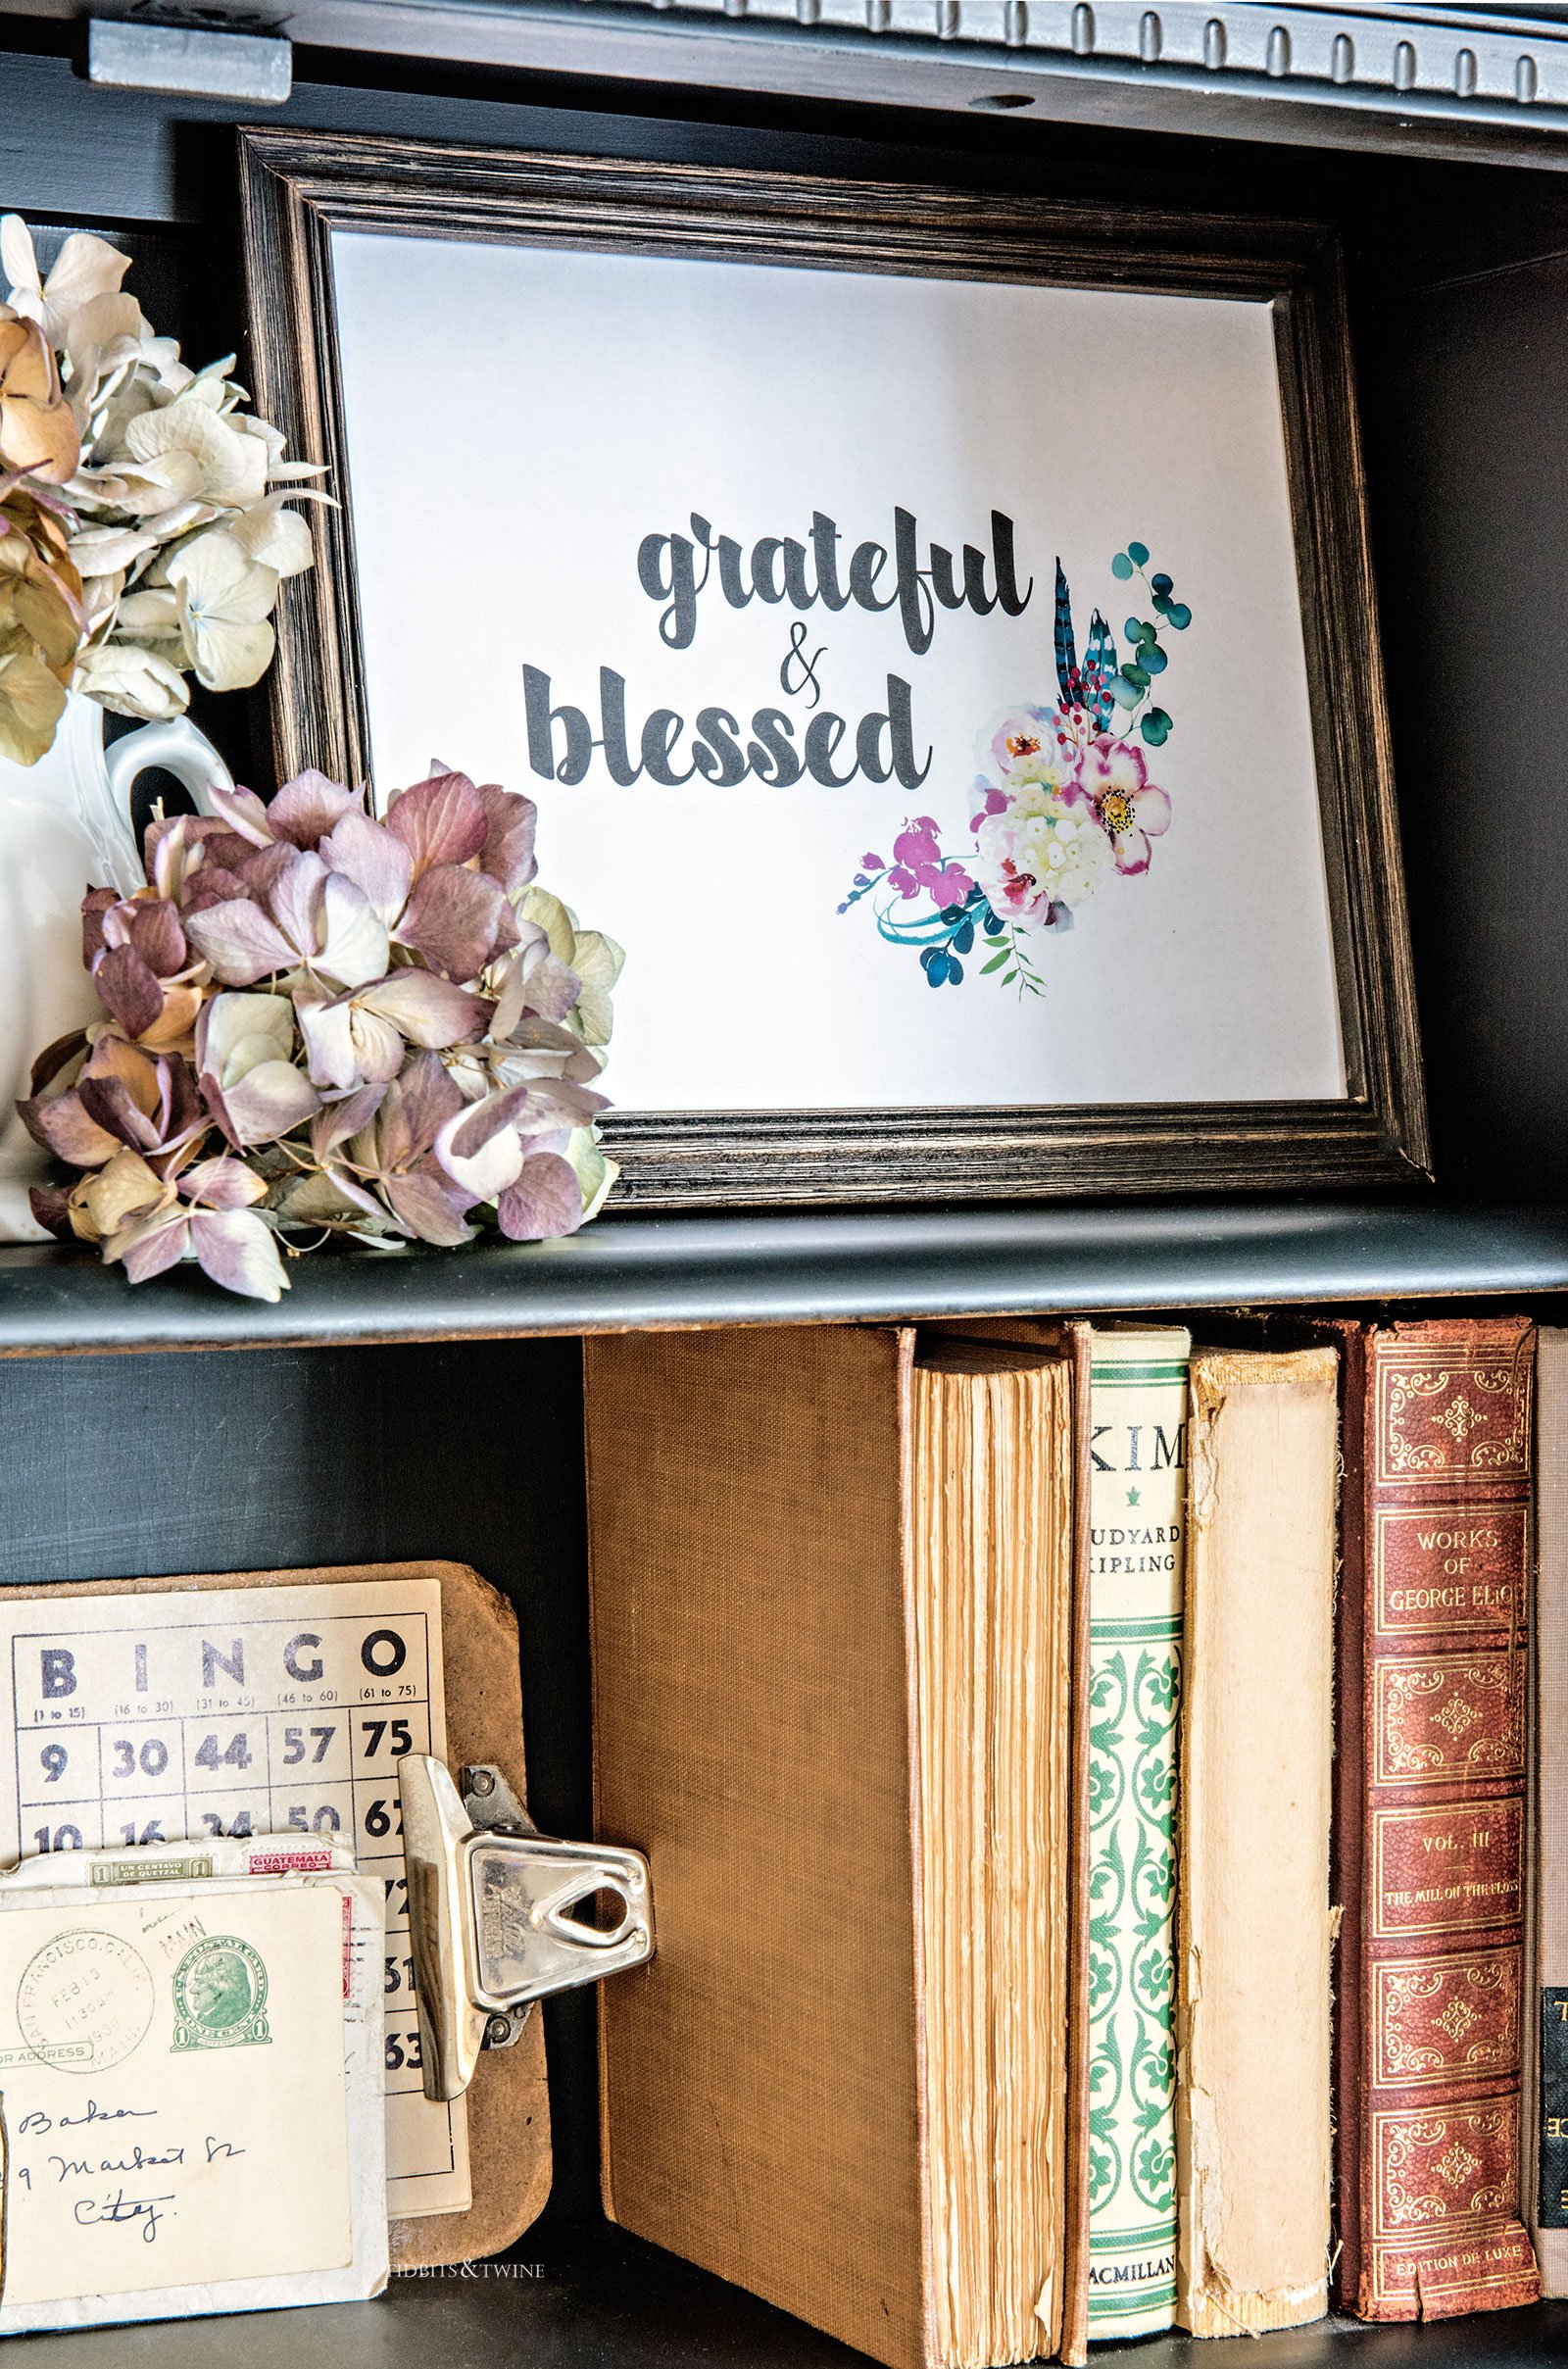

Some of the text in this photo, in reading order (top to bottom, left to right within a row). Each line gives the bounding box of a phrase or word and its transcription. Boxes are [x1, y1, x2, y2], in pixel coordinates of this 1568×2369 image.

[637, 506, 1033, 656] grateful
[780, 621, 827, 709] &
[522, 664, 932, 788] blessed
[1091, 1423, 1185, 1471] KIM
[1091, 1526, 1180, 1546] UDYARD
[1417, 1530, 1498, 1550] WORKS
[1091, 1555, 1175, 1573] IPLING
[1444, 1557, 1471, 1574] OF
[1390, 1587, 1466, 1610] GEORGE
[277, 1691, 338, 1705] (46 to 60)
[360, 1684, 416, 1701] (61 to 75)
[115, 1701, 173, 1716] (16 to 30)
[196, 1698, 213, 1710] (31
[219, 1698, 229, 1708] to
[40, 1719, 413, 1783] 9 30 44 57 75
[34, 1824, 82, 1853] 10
[120, 1819, 166, 1846] 16
[1422, 1831, 1490, 1852] VOL. III
[137, 1862, 182, 1871] CENTAVO
[254, 1854, 328, 1866] GUATEMALA
[138, 1868, 180, 1877] QUETZAL
[1385, 1879, 1519, 1905] THE MILL ON THE FLOSS
[18, 2047, 85, 2062] ADDRESS
[1089, 2254, 1175, 2285] ACMILLAN
[1396, 2245, 1522, 2276] EDITION DE LUXE
